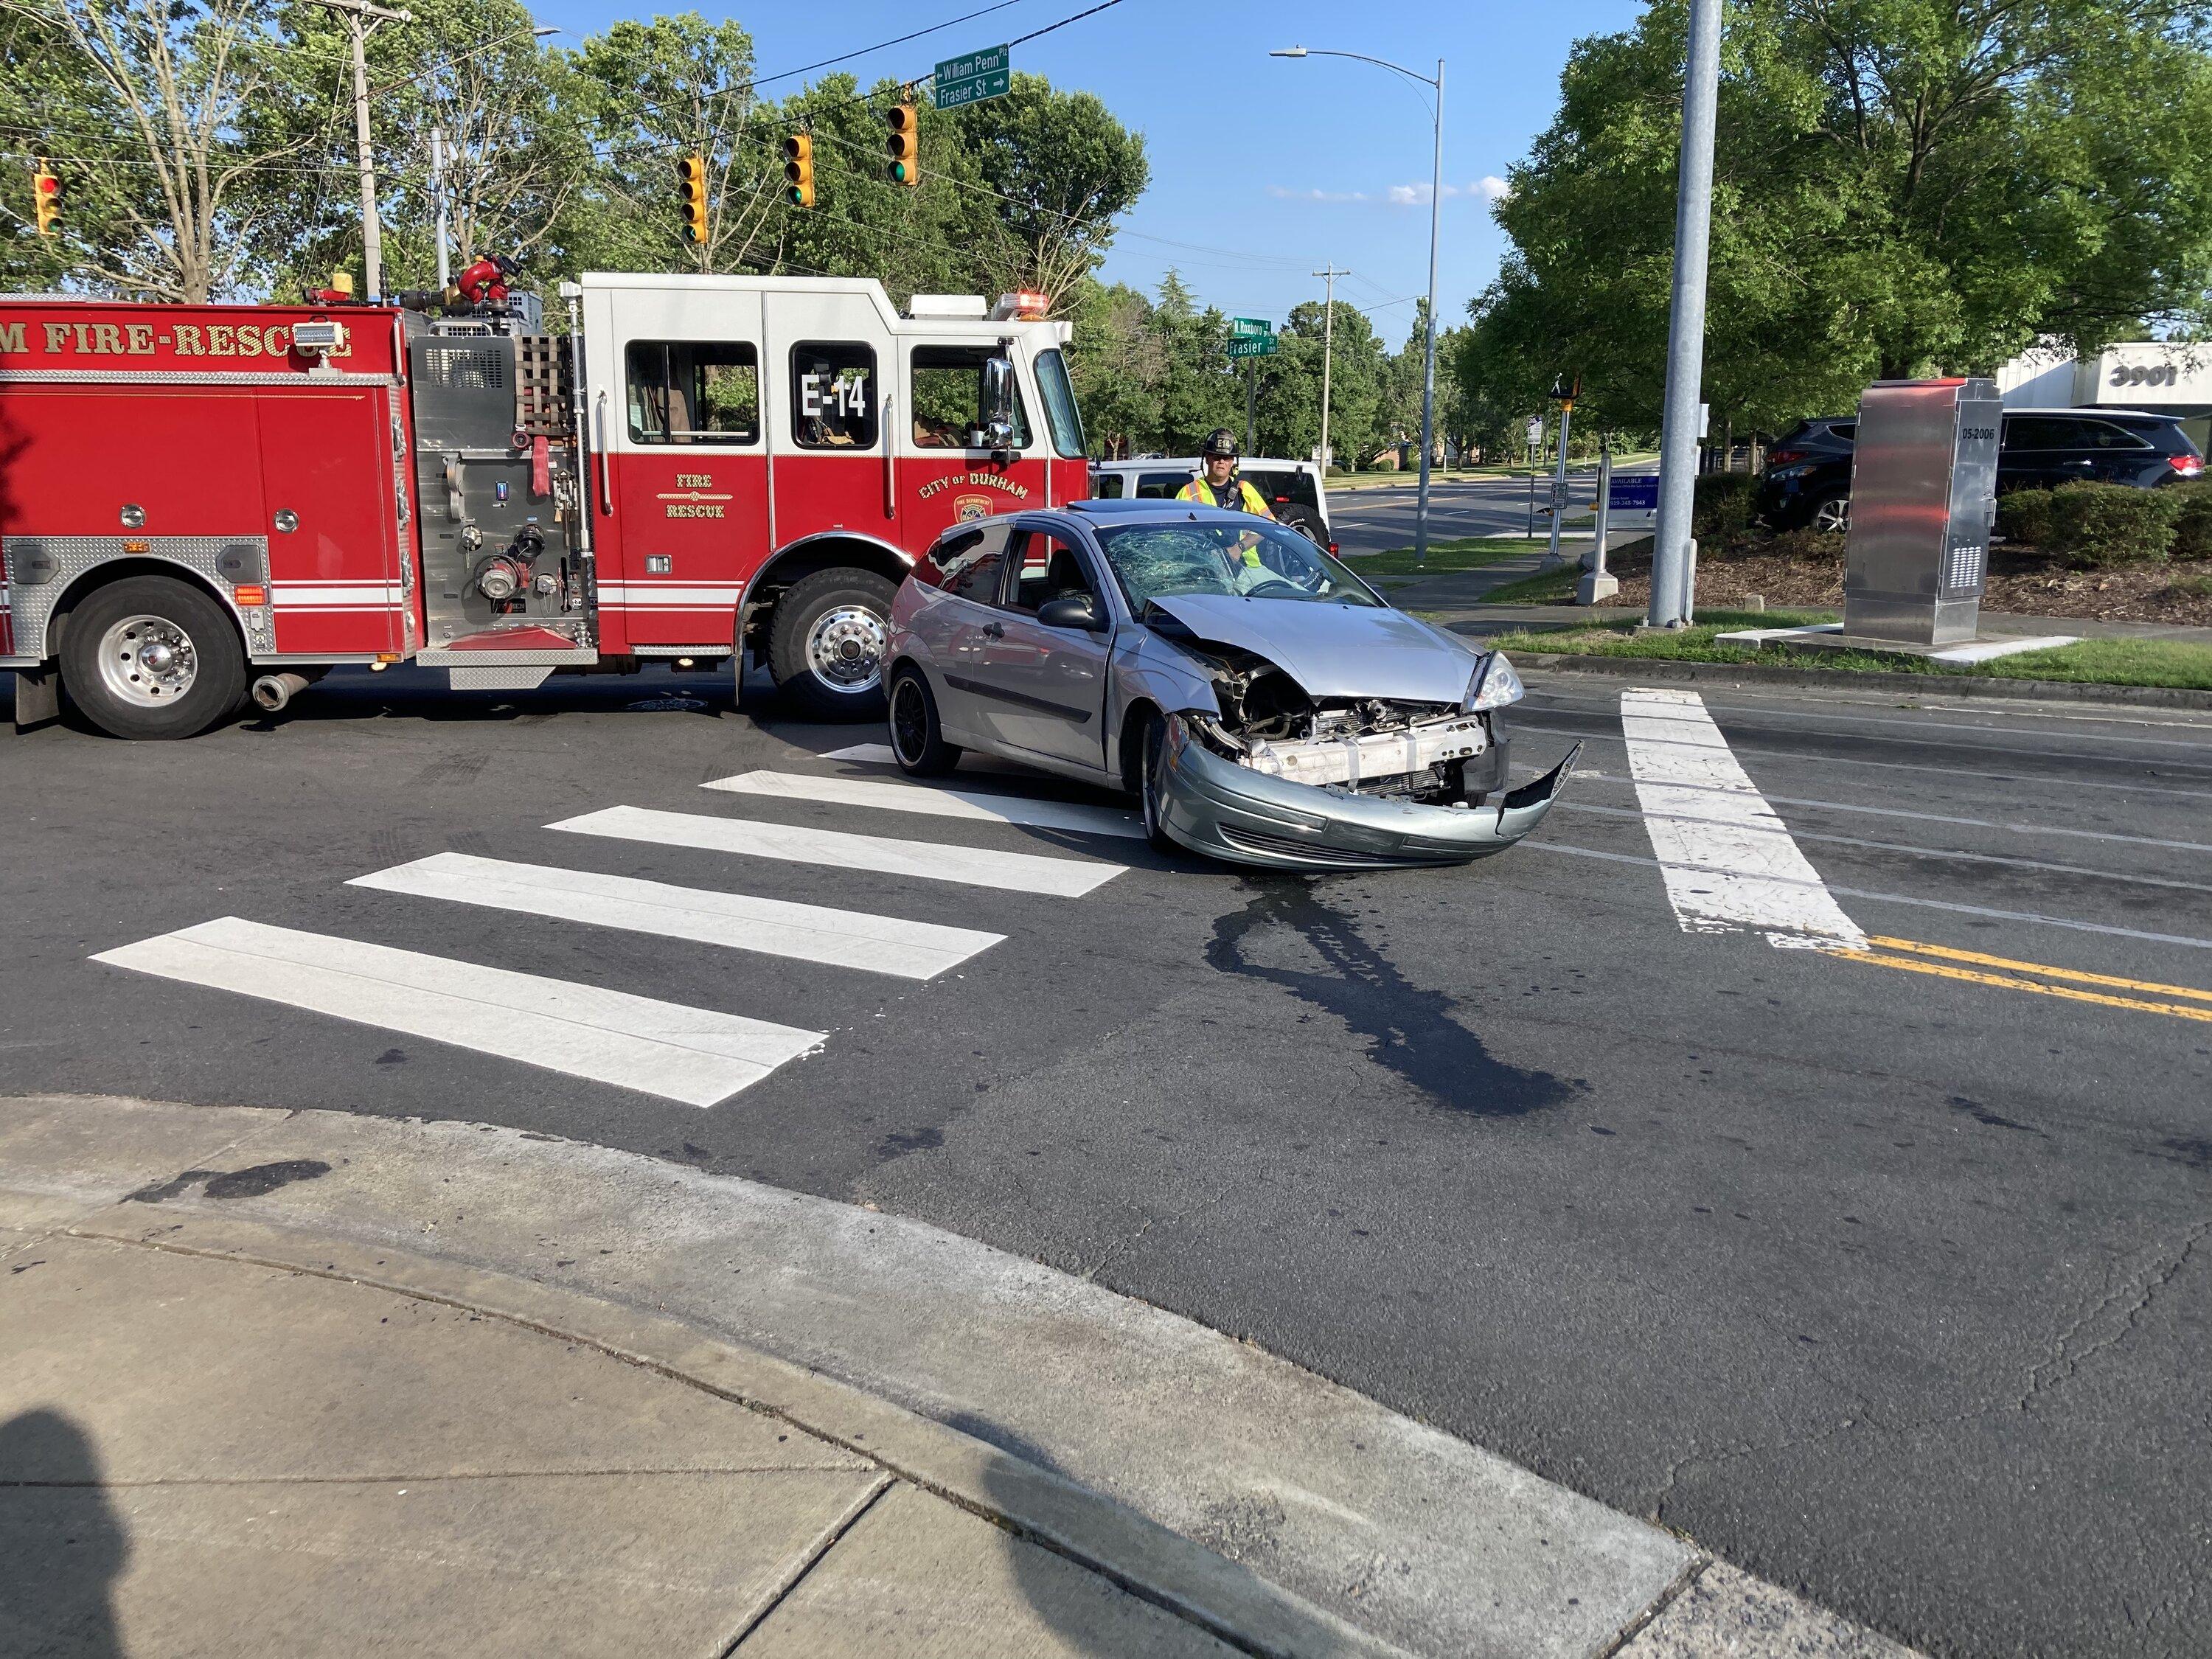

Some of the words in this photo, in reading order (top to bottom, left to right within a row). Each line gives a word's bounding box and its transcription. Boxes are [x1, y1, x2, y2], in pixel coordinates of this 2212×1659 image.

[943, 61, 973, 80] William
[975, 55, 998, 72] Penn
[998, 47, 1007, 57] Plz
[940, 84, 972, 105] Frasier
[975, 79, 987, 97] St
[1240, 321, 1262, 335] Roxboro
[1229, 340, 1262, 355] Frasier
[2109, 365, 2178, 387] 3901
[801, 375, 866, 417] E-14
[1217, 439, 1231, 448] E14
[675, 473, 712, 488] FIRE
[918, 476, 950, 500] CITY
[952, 475, 966, 485] OF
[969, 473, 1029, 500] DURHAM
[966, 498, 990, 506] DEPARTMENT
[666, 504, 725, 518] RESCUE
